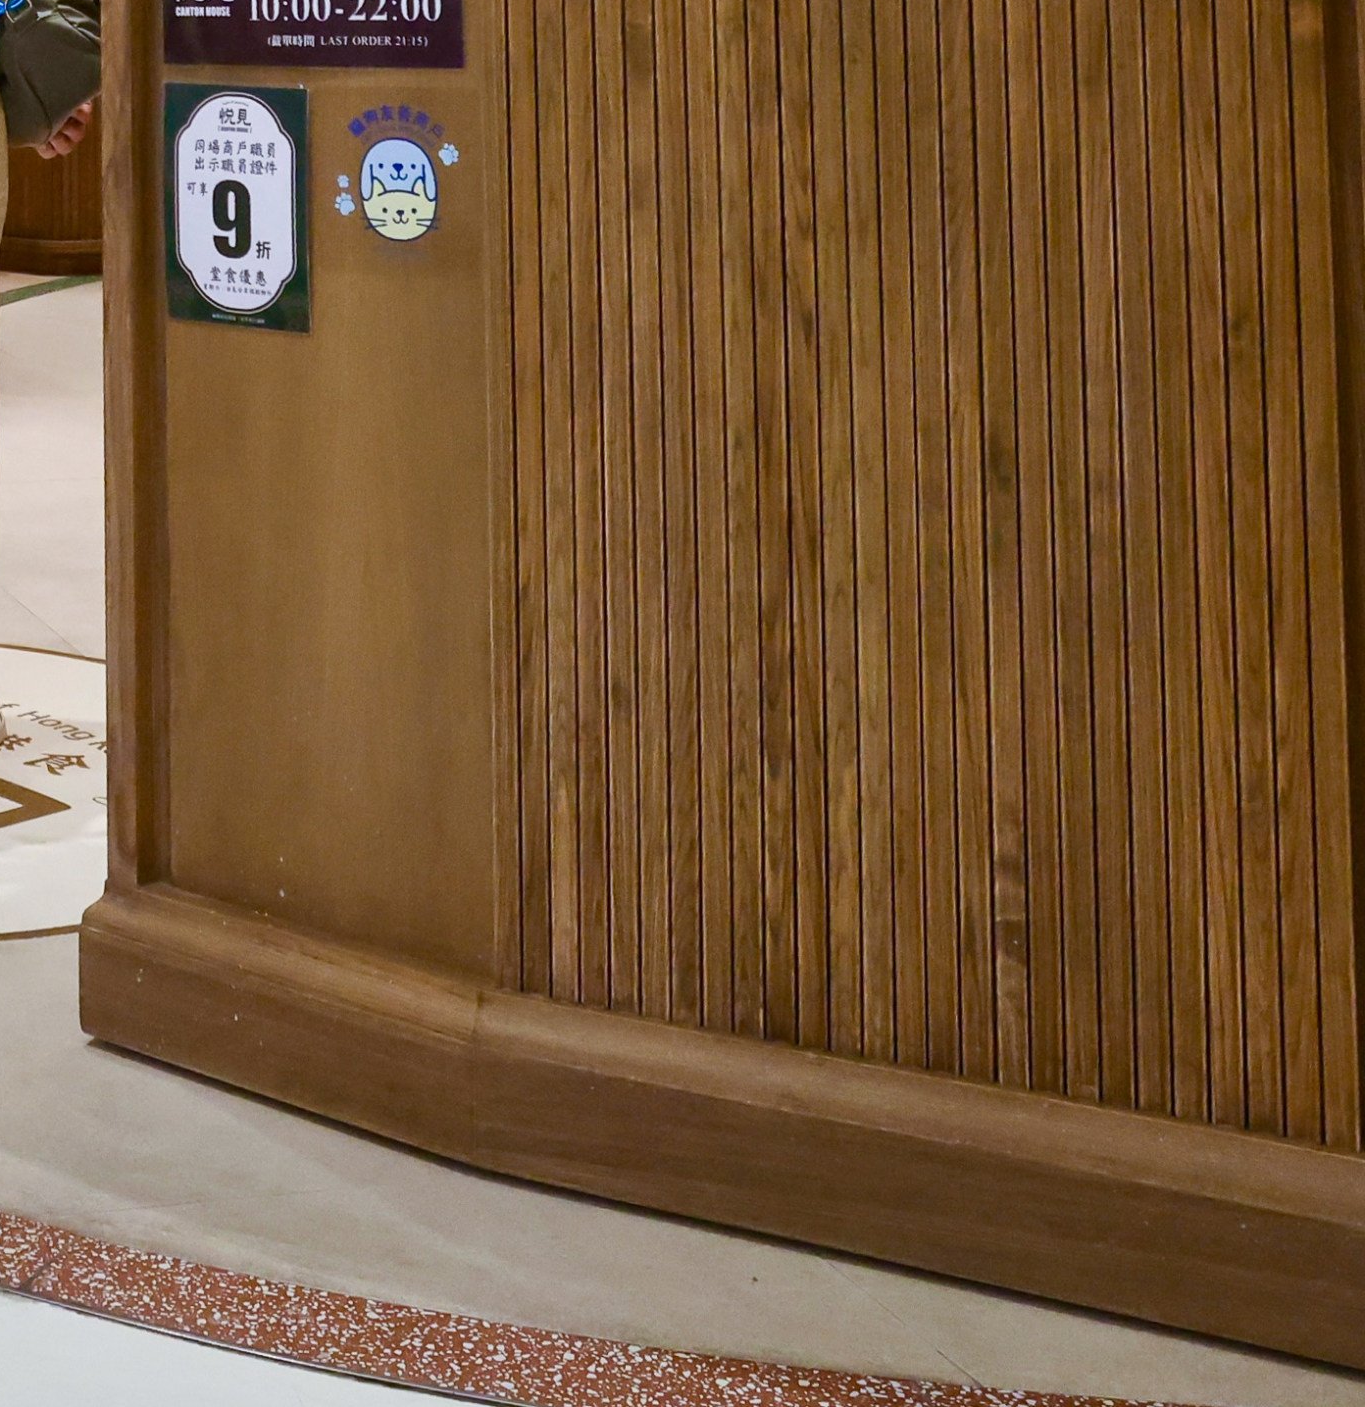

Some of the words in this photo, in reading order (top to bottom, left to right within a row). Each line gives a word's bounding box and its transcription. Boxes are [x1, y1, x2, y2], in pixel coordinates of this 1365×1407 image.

[175, 5, 205, 17] CANTON
[205, 5, 231, 17] HOUSE
[320, 35, 348, 47] LAST
[352, 35, 392, 47] ORDER
[212, 179, 251, 259] 9
[256, 241, 271, 260] 折
[18, 710, 95, 741] Hong
